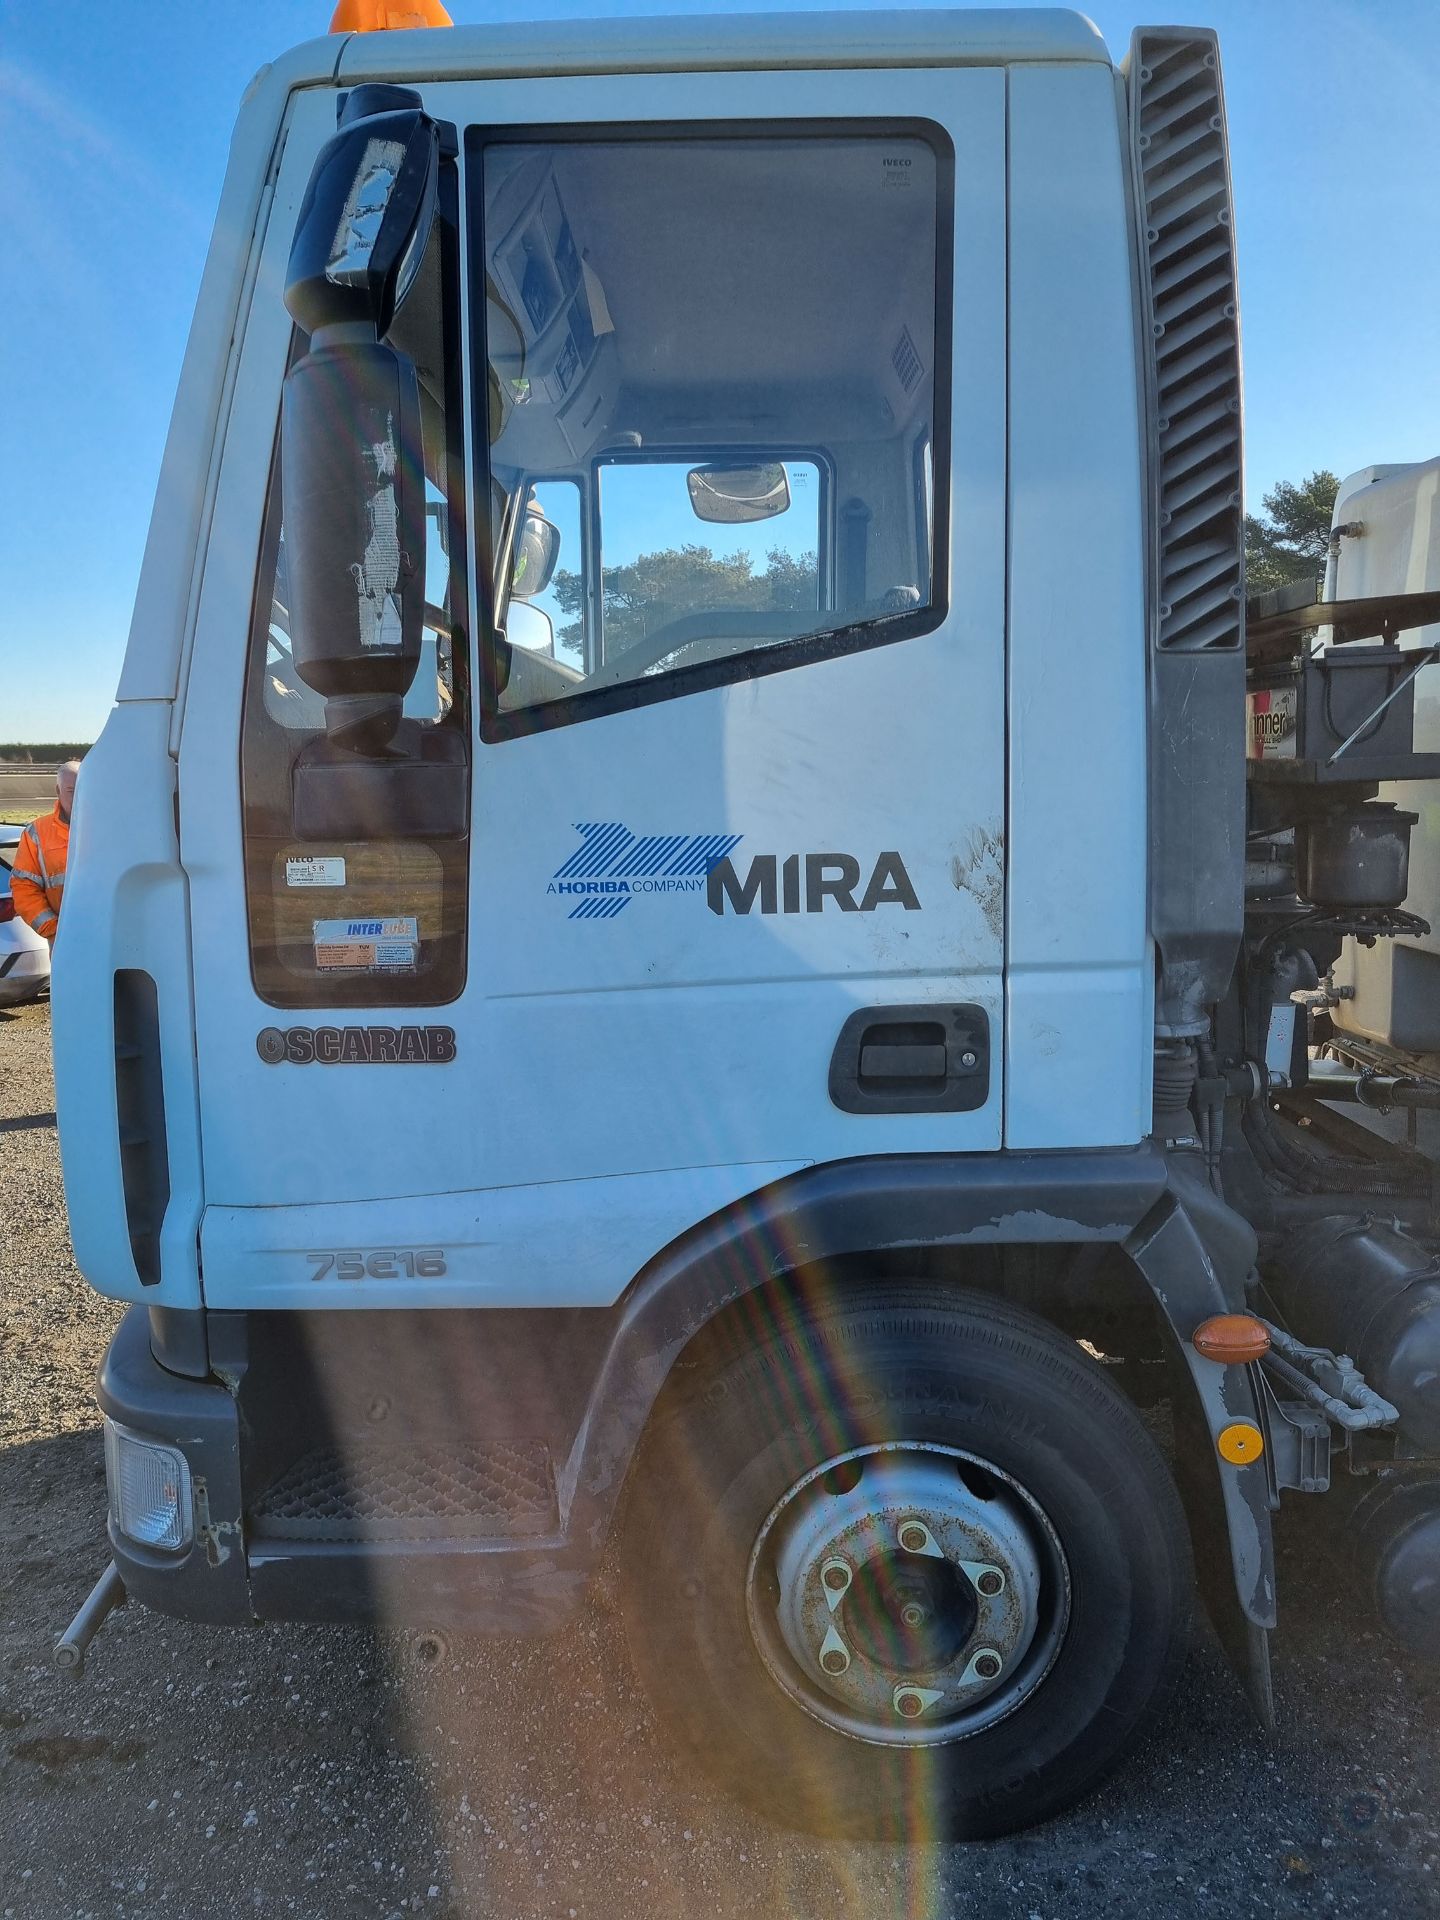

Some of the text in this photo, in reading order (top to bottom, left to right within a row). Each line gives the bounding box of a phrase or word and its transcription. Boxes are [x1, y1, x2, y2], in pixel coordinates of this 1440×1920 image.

[882, 159, 912, 167] IVECO
[546, 880, 705, 894] A HORIBA COMPANY
[707, 851, 923, 916] MIRA
[286, 1026, 456, 1063] SCARAB
[306, 1250, 447, 1282] 75E16
